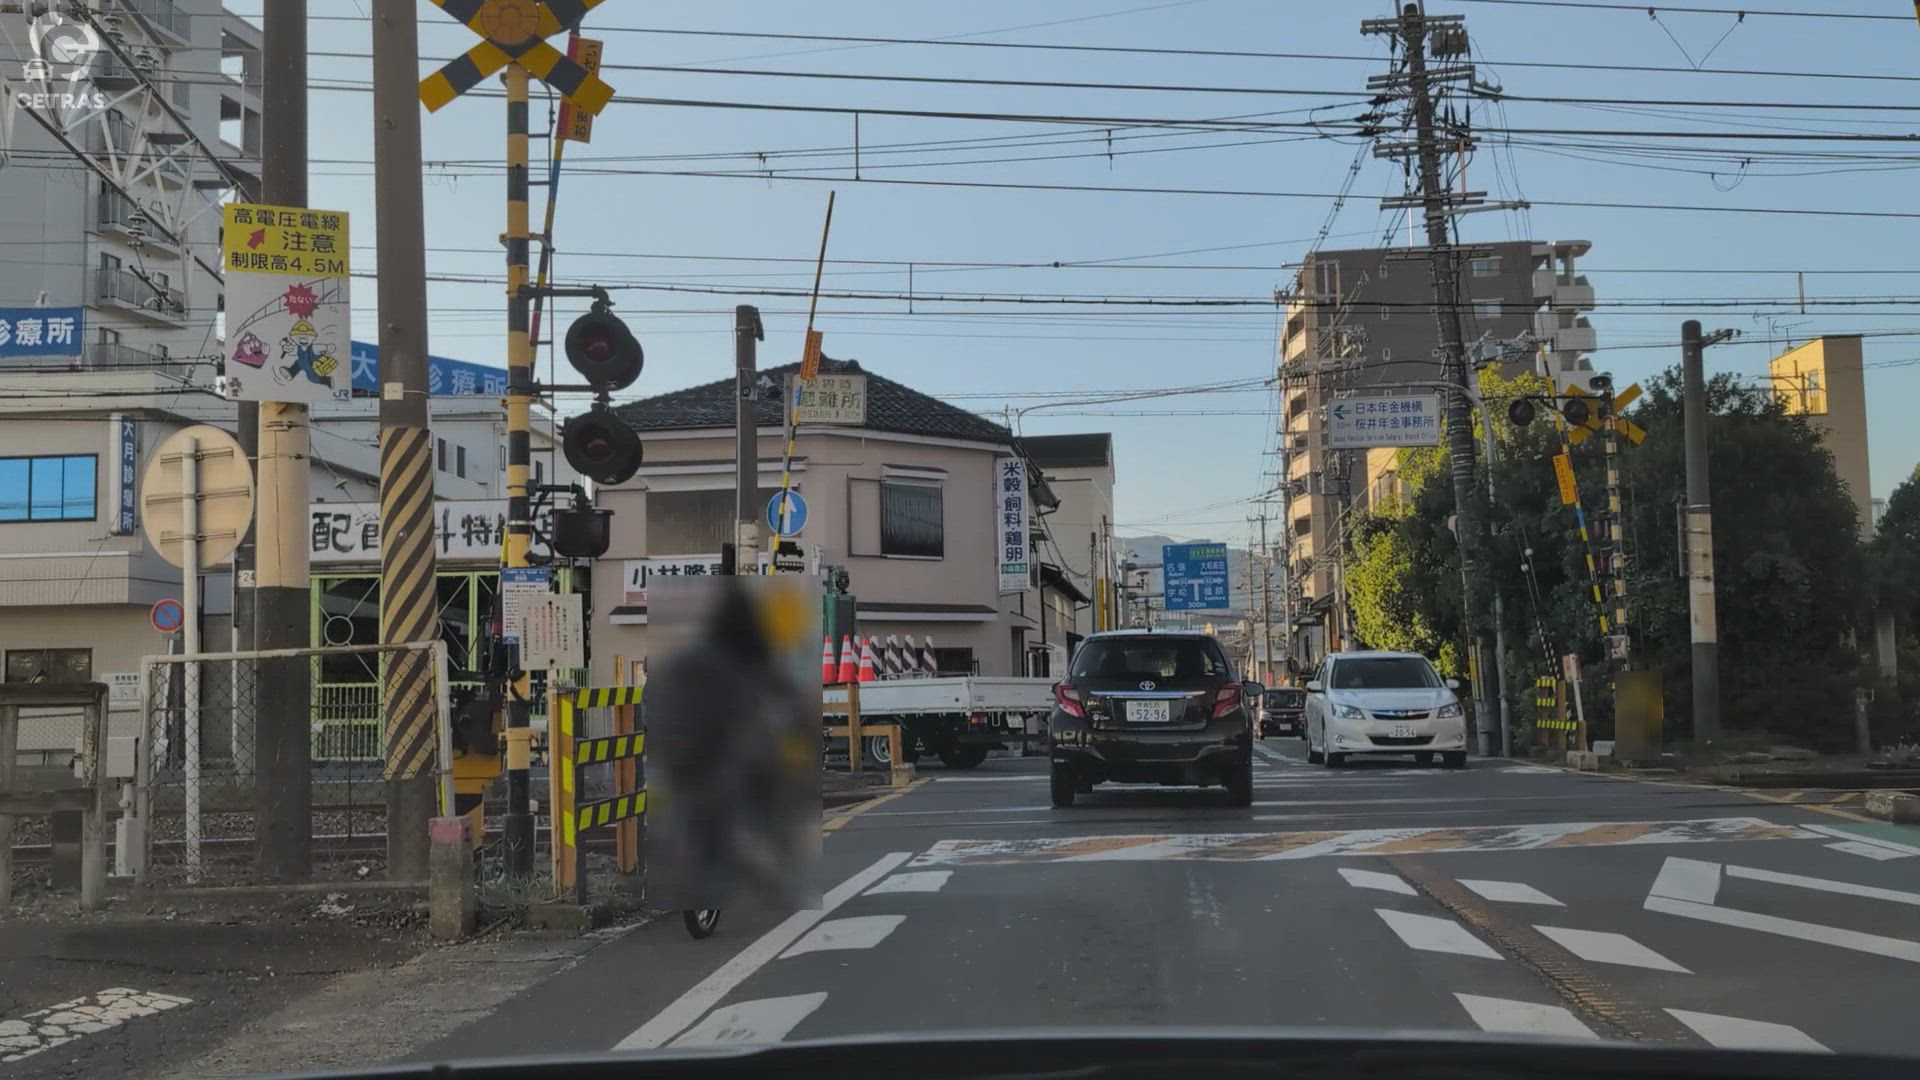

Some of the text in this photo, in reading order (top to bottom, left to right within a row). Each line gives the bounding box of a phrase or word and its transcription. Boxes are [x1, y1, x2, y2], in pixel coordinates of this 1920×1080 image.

[233, 207, 341, 231] 高電圧電線
[281, 230, 336, 254] 注意
[231, 250, 345, 275] 制限高4.5M
[333, 389, 349, 398] JR
[1355, 400, 1423, 414] 日本年金機構
[1355, 415, 1435, 430] 桜井年金事務所
